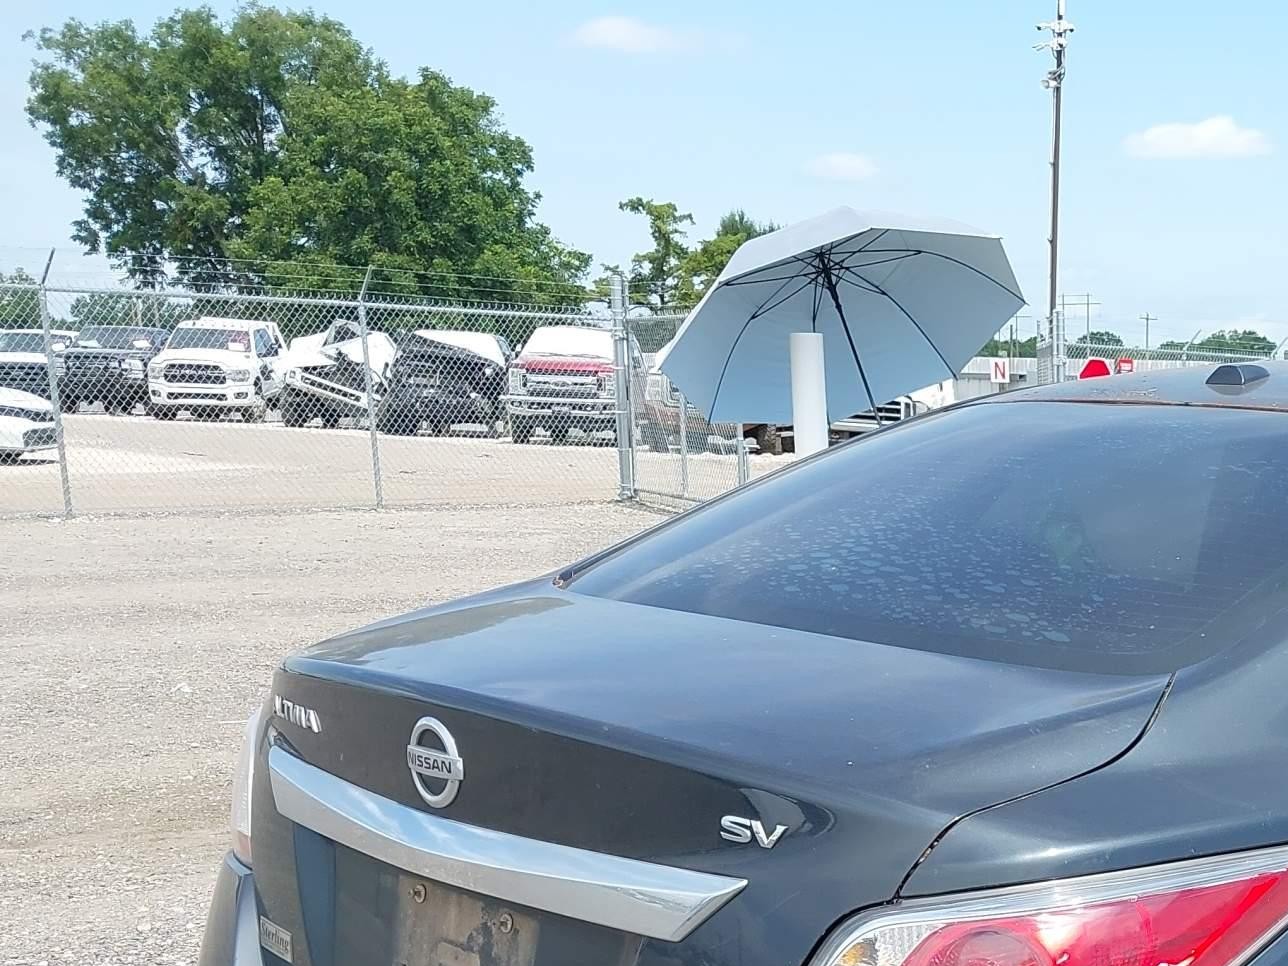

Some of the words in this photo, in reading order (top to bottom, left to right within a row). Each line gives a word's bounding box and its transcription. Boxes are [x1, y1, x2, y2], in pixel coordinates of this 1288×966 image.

[993, 361, 1006, 380] N
[408, 751, 452, 774] NISSAN
[720, 815, 788, 849] SV
[261, 920, 290, 954] Sterling
